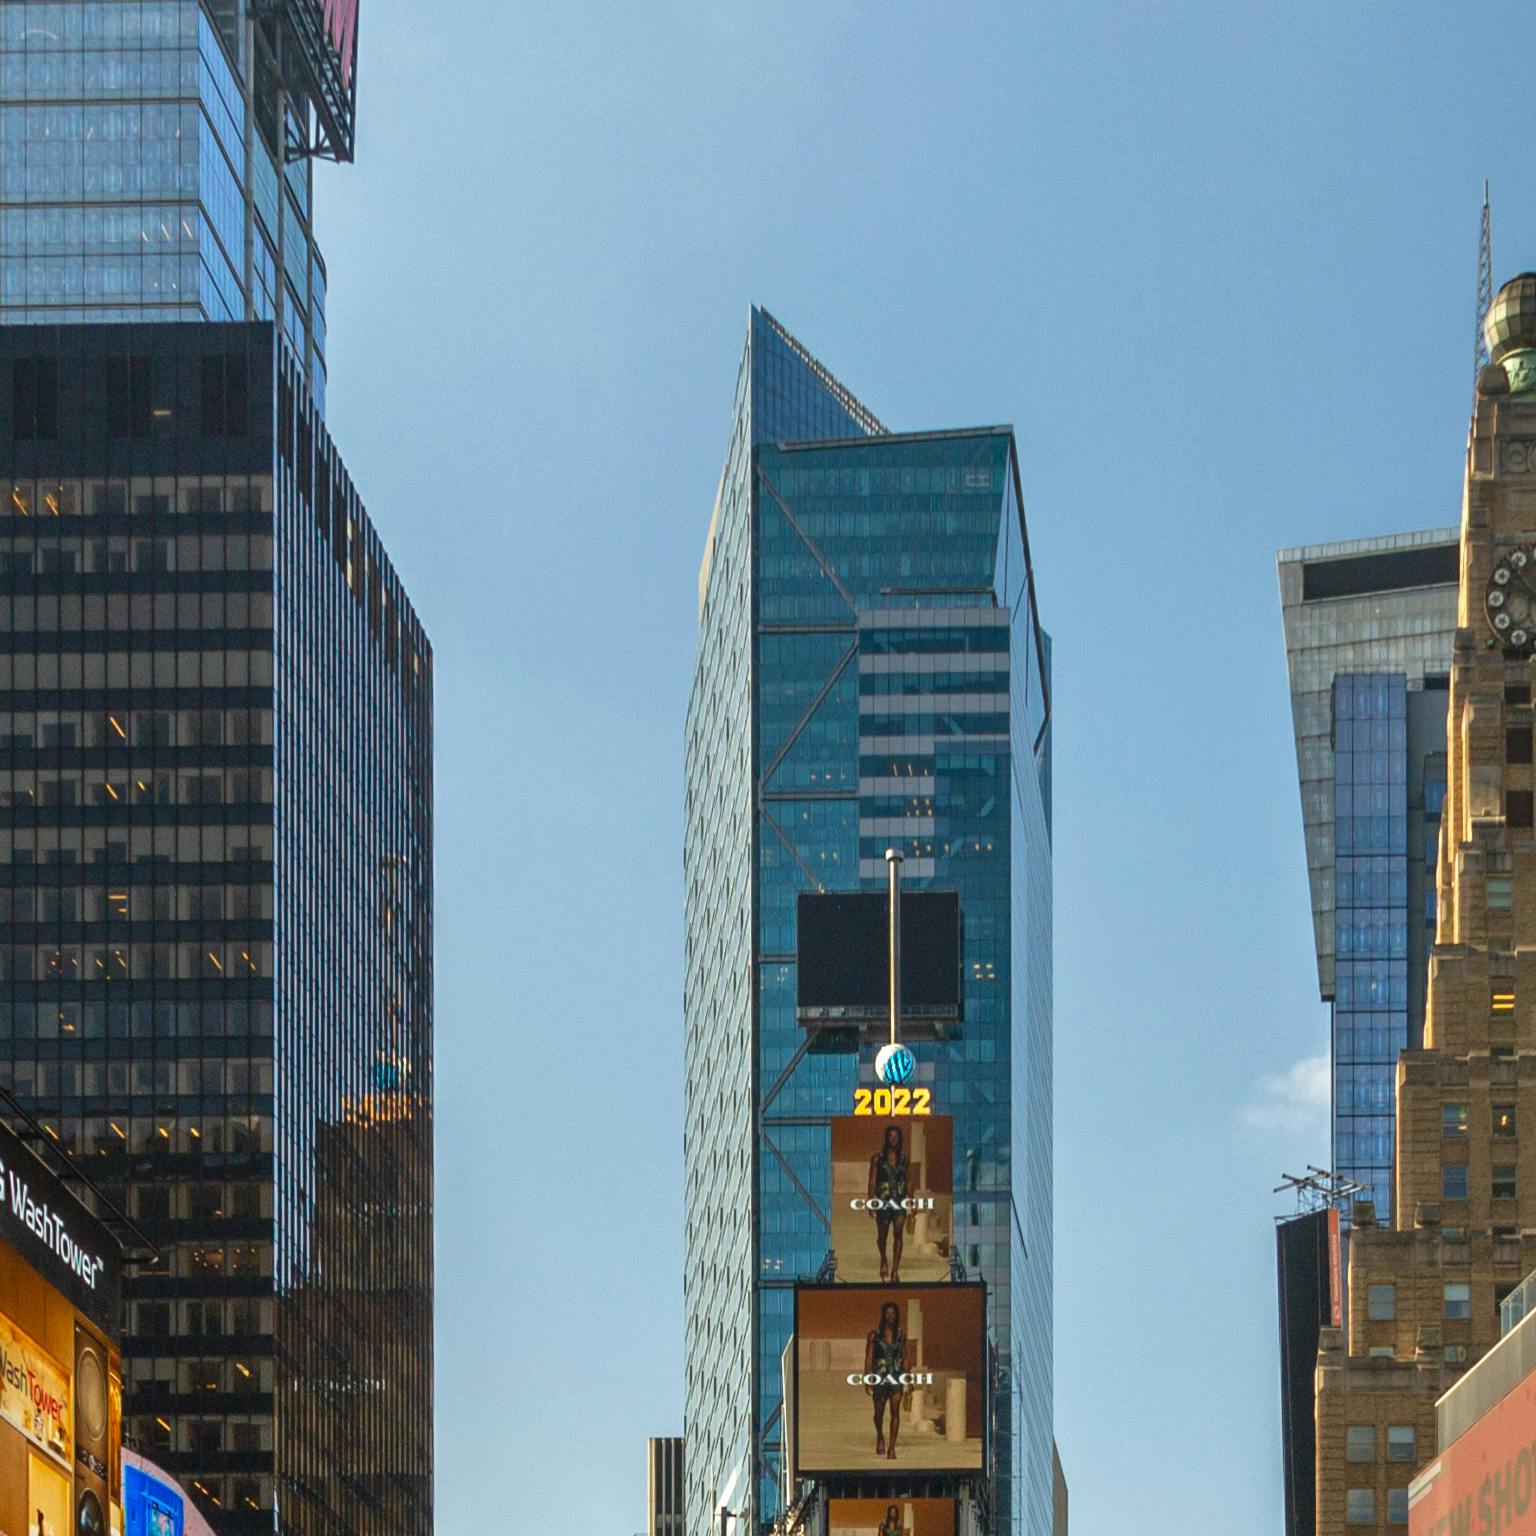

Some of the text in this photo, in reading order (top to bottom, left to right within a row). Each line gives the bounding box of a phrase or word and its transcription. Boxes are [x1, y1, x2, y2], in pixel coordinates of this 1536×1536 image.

[853, 1087, 932, 1117] 2022
[849, 1197, 935, 1211] COACH
[846, 1372, 934, 1387] COACH
